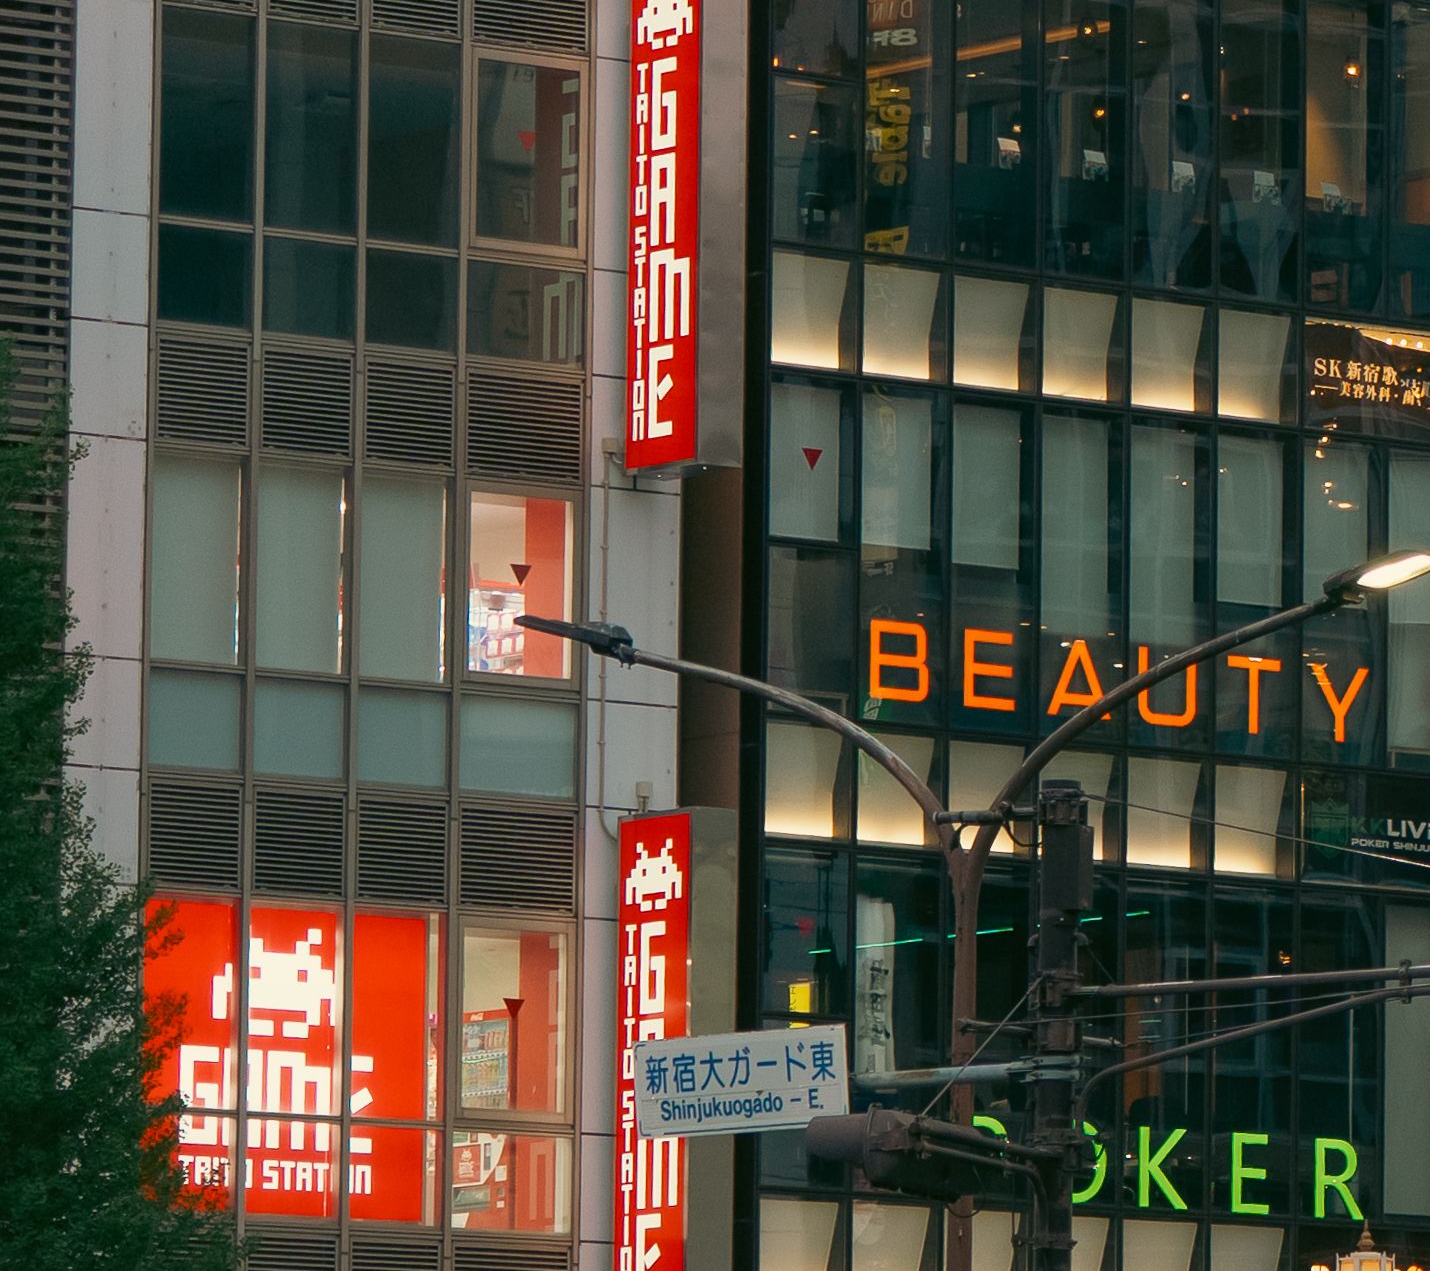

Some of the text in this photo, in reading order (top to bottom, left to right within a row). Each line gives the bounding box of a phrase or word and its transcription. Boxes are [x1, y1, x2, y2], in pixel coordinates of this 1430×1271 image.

[633, 63, 648, 444] TAITO STATION
[649, 59, 692, 440] GAME
[869, 618, 1369, 742] BEAUTY
[644, 1041, 836, 1094] 新宿大ガード東
[660, 1092, 784, 1121] Shinjukuogado
